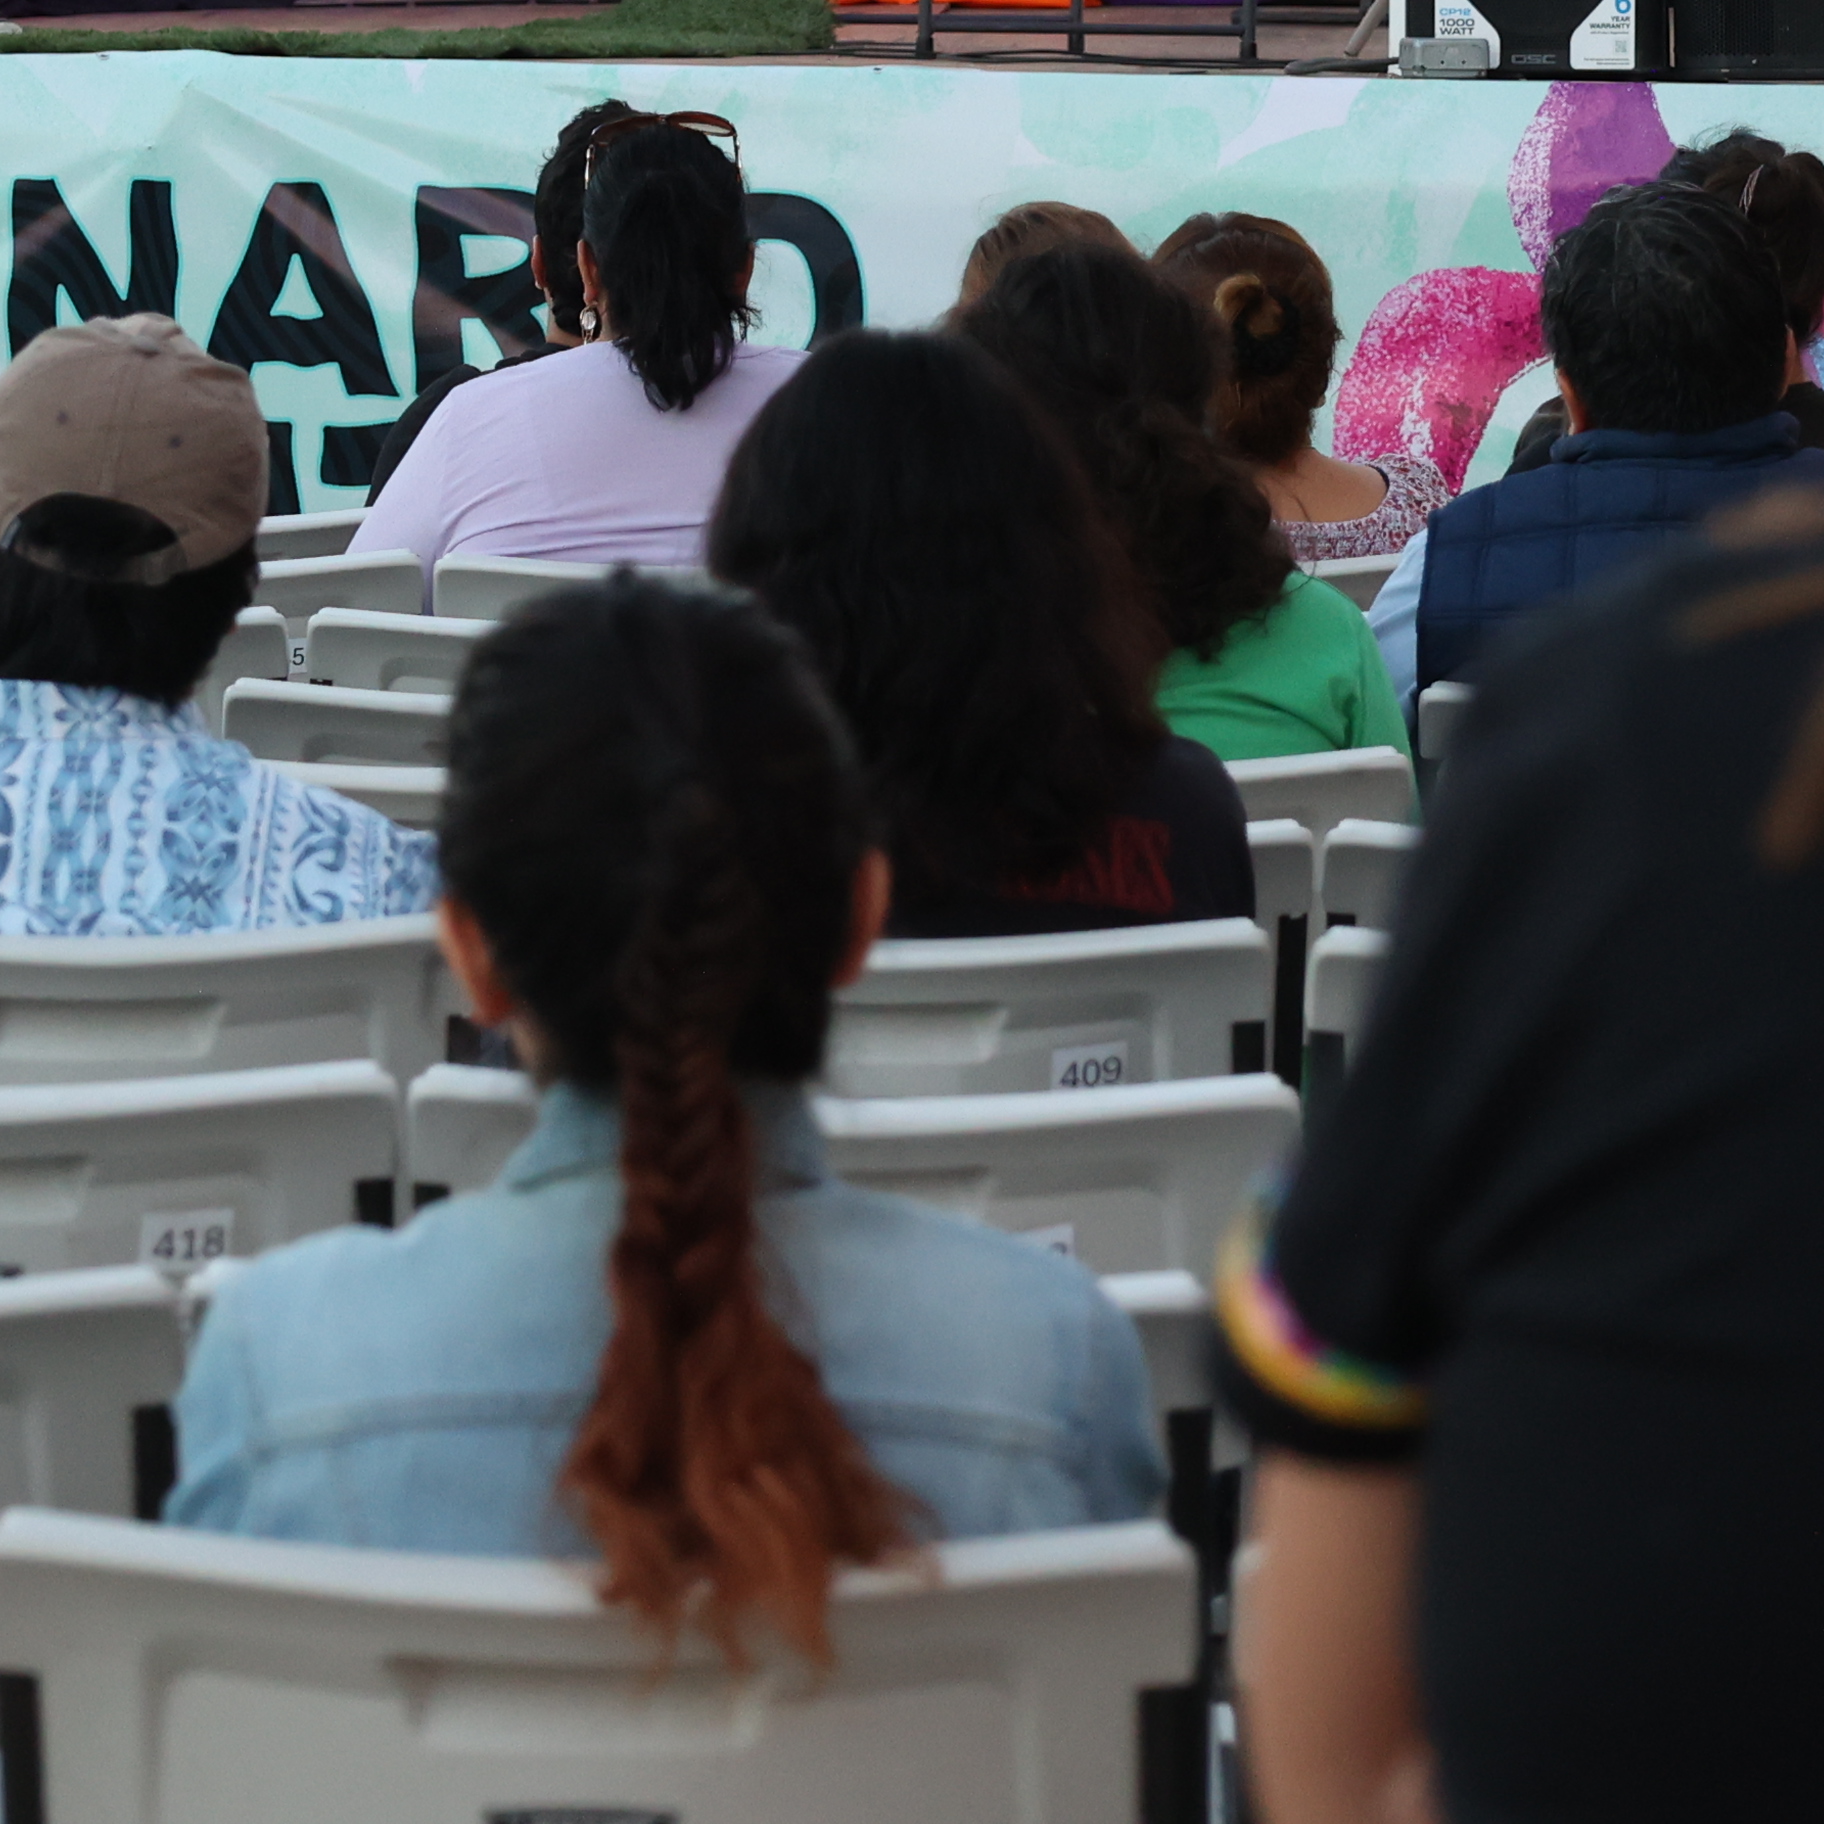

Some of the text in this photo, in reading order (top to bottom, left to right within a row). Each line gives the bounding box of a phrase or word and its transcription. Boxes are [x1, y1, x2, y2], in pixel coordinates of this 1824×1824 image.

[1439, 8, 1471, 16] CP12
[1439, 18, 1475, 27] 1000
[1439, 27, 1475, 35] WATT
[1059, 1056, 1122, 1087] 409
[153, 1225, 225, 1259] 418
